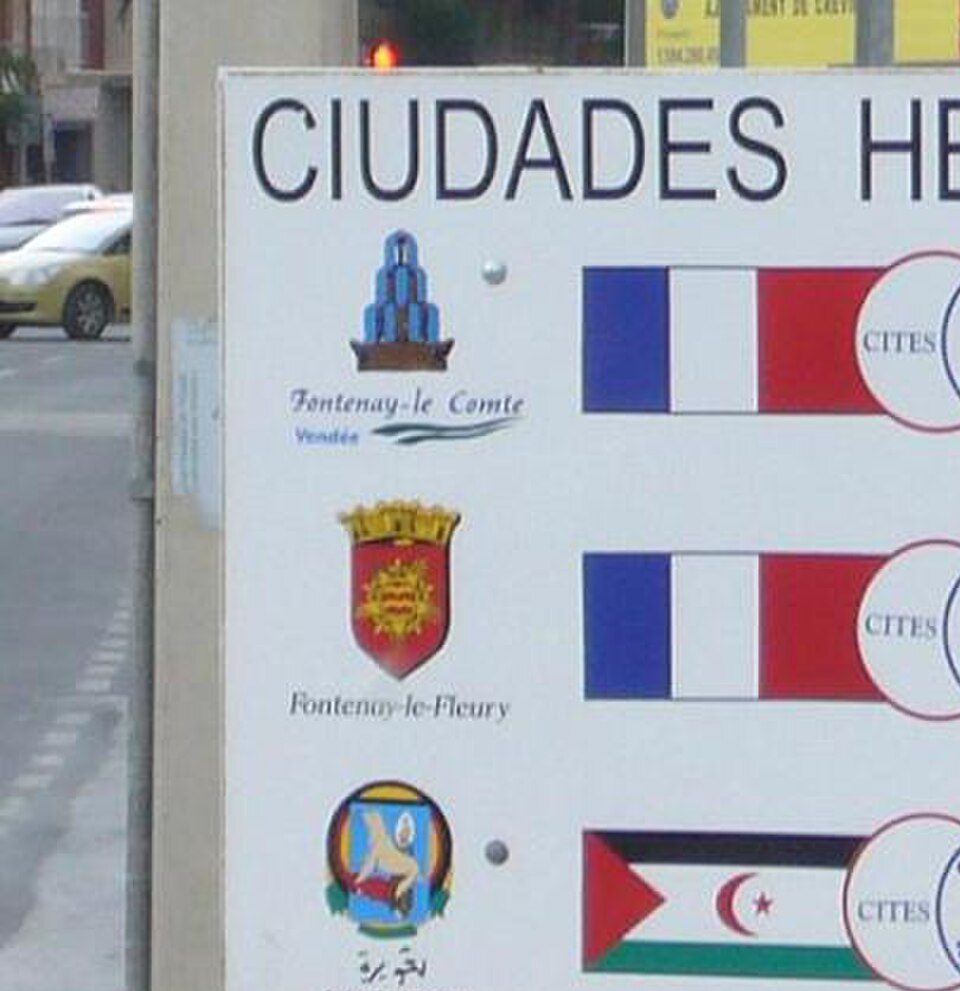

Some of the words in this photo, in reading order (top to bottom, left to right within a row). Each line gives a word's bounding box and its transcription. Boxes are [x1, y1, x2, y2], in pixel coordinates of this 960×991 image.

[252, 96, 789, 203] CIUDADES
[863, 331, 937, 353] CITES
[290, 387, 433, 419] Fontenay-le
[448, 389, 525, 415] Comte
[865, 614, 938, 638] CITES
[857, 900, 931, 924] CITES
